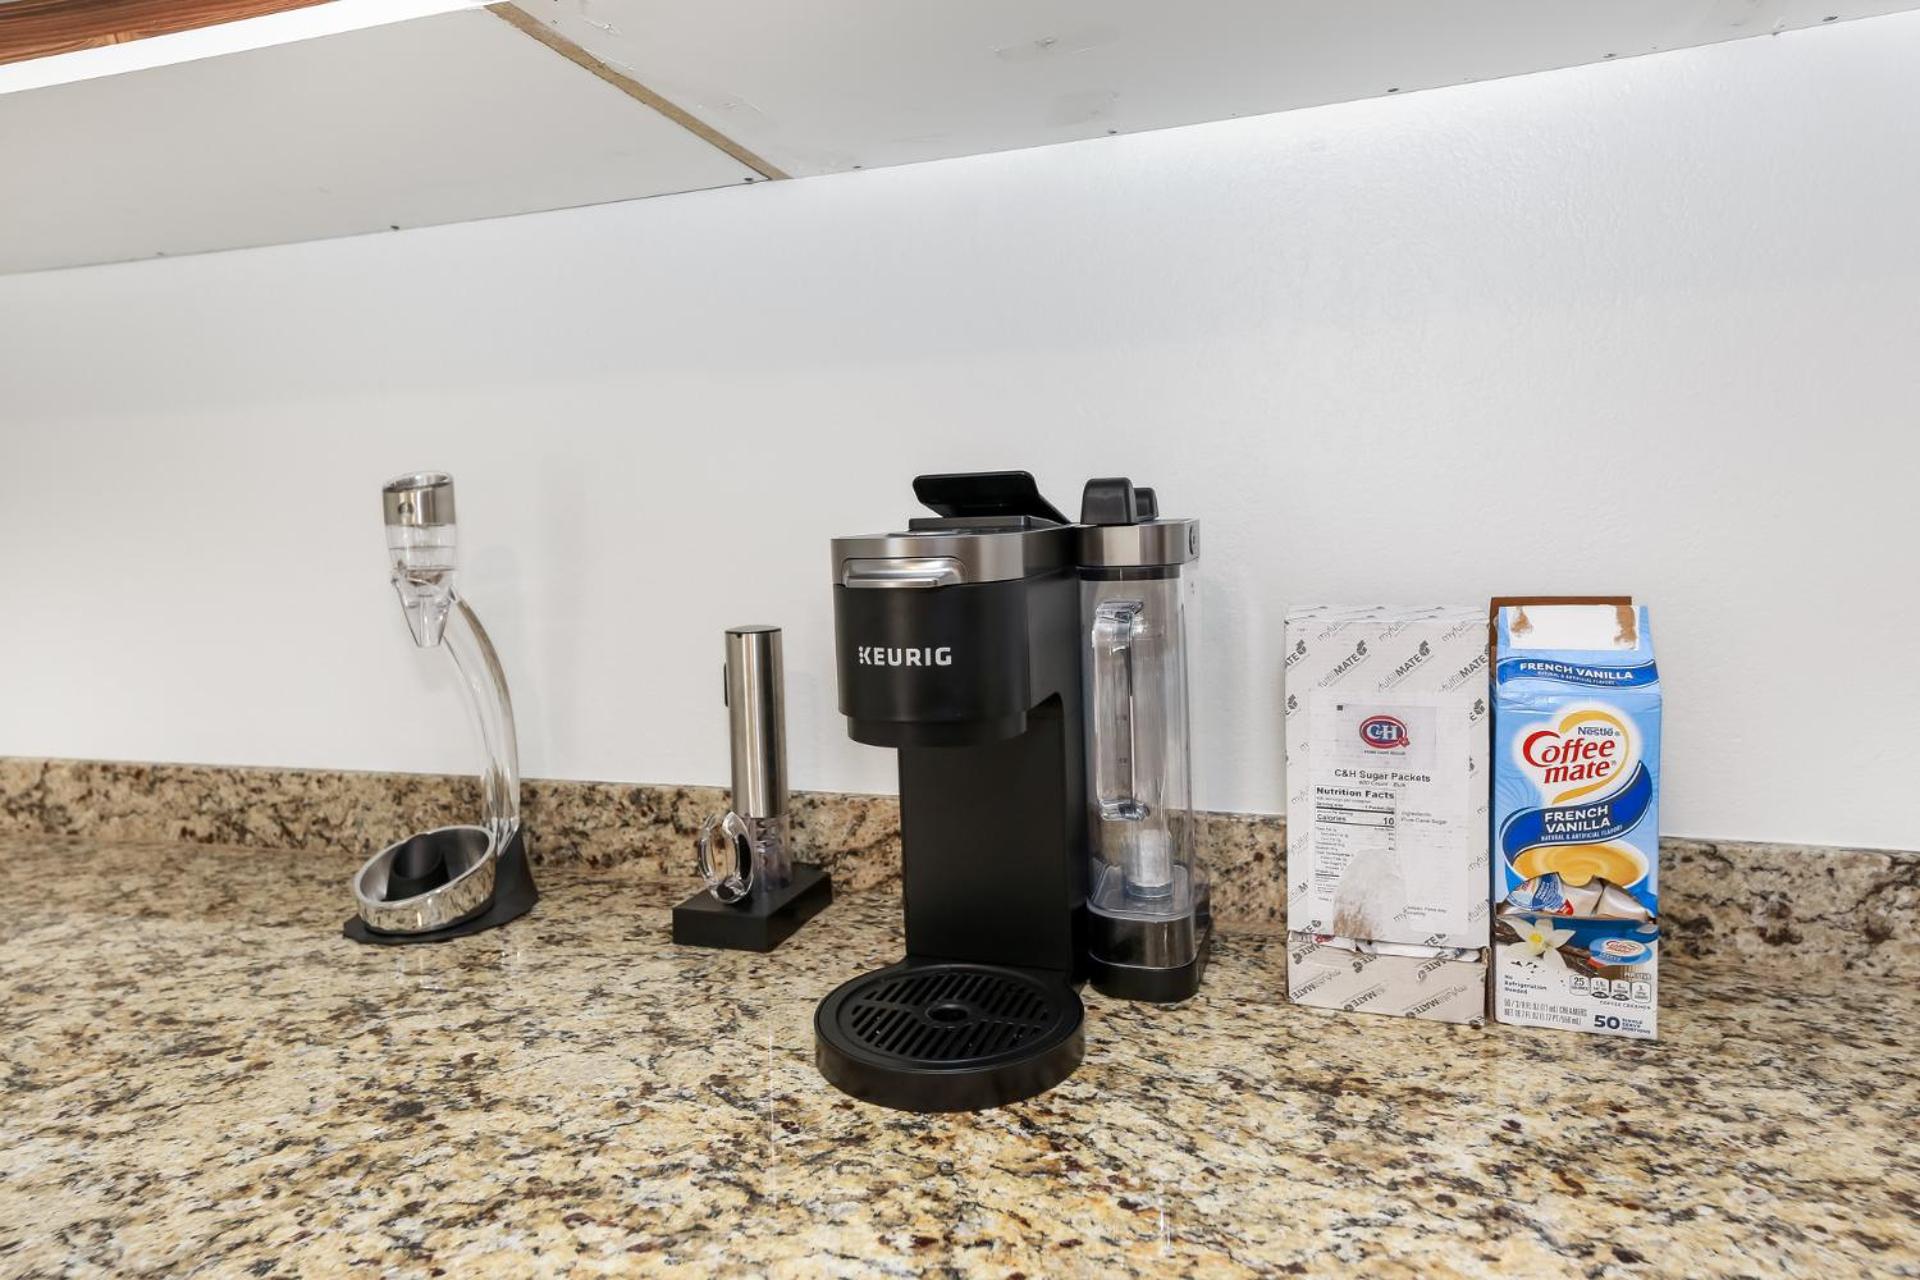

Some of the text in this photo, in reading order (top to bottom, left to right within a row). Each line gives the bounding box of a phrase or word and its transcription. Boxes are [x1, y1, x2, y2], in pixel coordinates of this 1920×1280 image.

[858, 646, 952, 666] KEURIG
[1520, 662, 1634, 679] FRENCH VANILLA
[1522, 730, 1616, 768] Coffee
[1334, 769, 1431, 783] C&H Sugar Packets
[1544, 760, 1610, 784] mate
[1316, 787, 1395, 799] Nutrition Facts
[1384, 817, 1395, 825] 10
[1545, 805, 1608, 823] FRENCH
[1546, 817, 1610, 833] VANILLA
[1574, 977, 1585, 986] 25
[1594, 1015, 1620, 1029] 50
